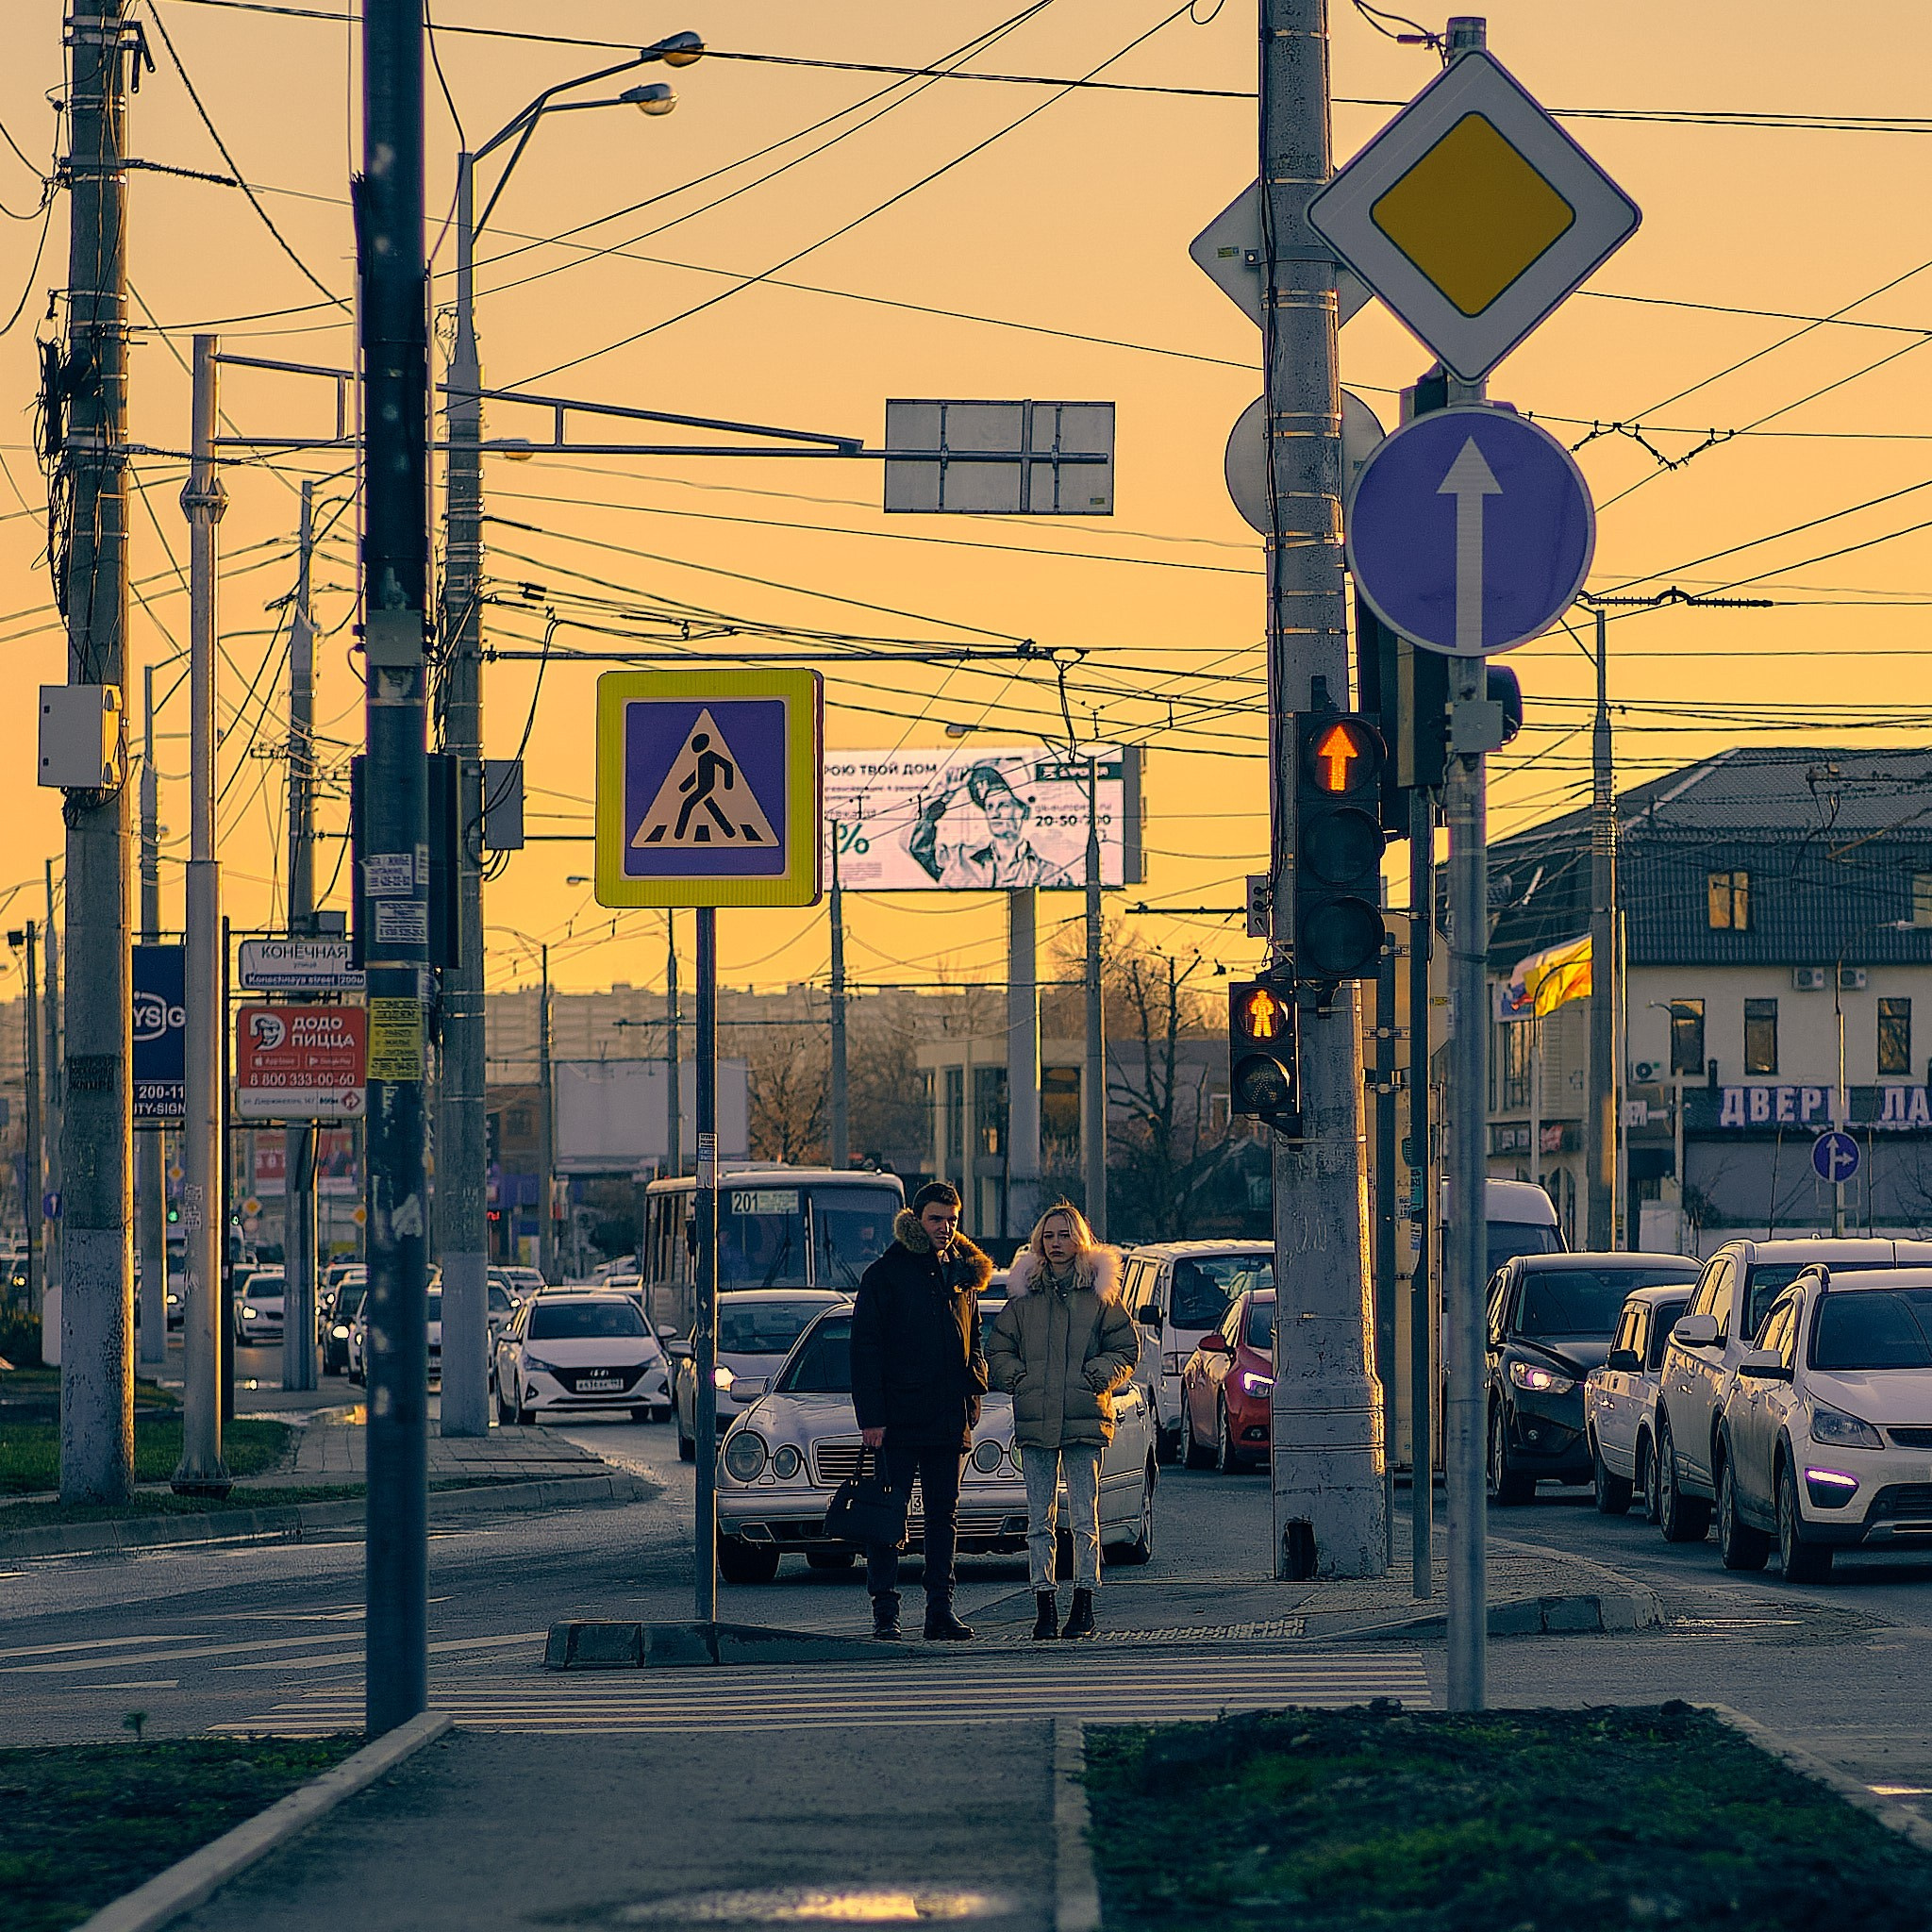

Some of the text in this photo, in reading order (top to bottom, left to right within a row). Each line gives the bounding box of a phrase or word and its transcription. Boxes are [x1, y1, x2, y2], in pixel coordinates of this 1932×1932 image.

[860, 761, 898, 775] ТВОЙ
[903, 764, 937, 775] ДОМ
[261, 944, 349, 960] КОНЕЧНАЯ
[291, 1017, 343, 1032] ДОДО
[291, 1034, 355, 1049] ПИЦЦА
[250, 1073, 356, 1086] 8 800 333-00-60
[1720, 1087, 1851, 1127] ДВЕРИ
[734, 1192, 758, 1212] 201
